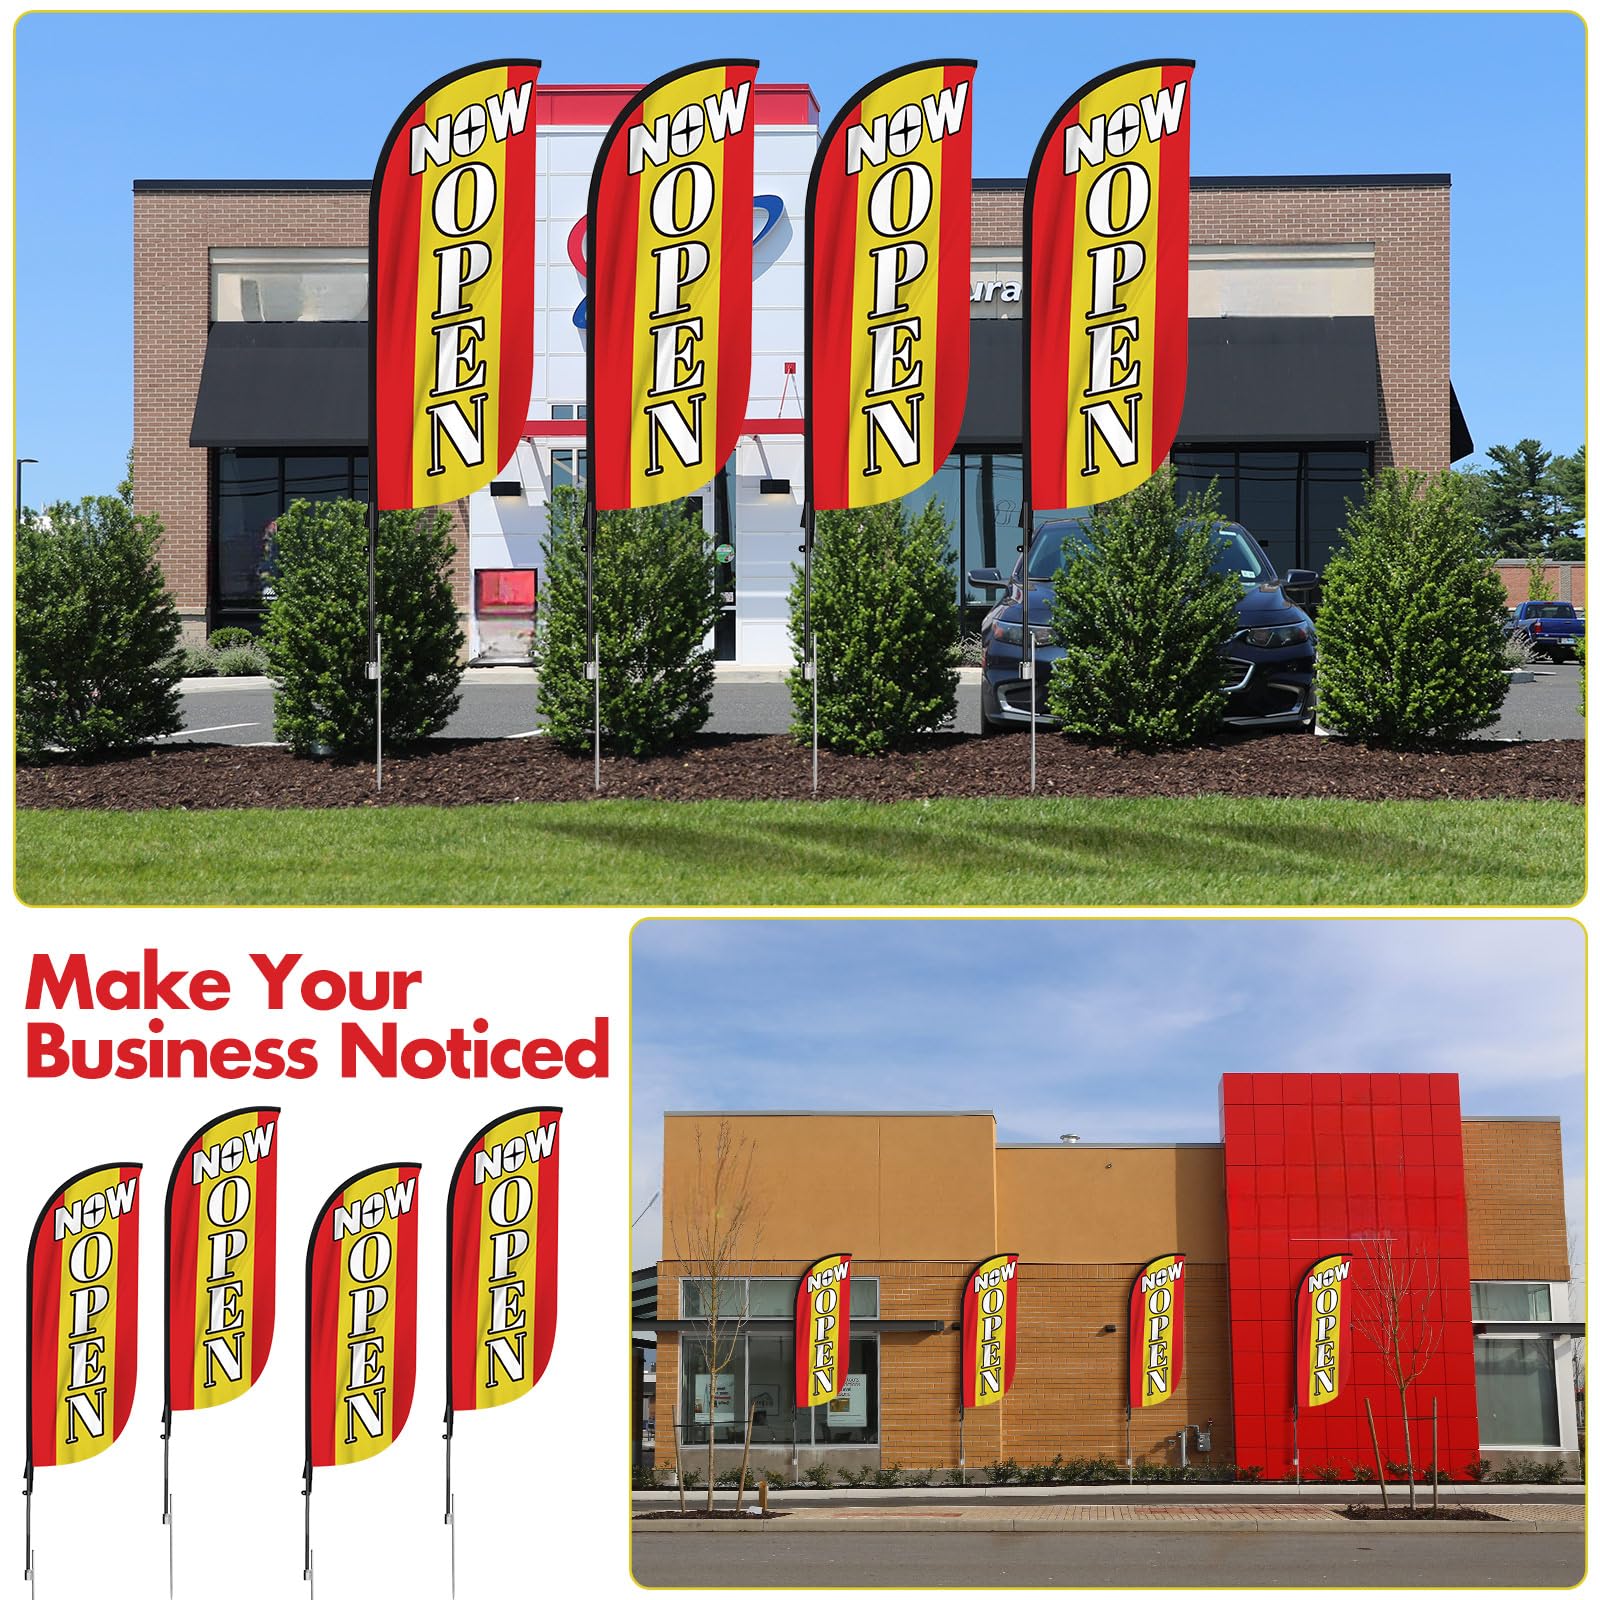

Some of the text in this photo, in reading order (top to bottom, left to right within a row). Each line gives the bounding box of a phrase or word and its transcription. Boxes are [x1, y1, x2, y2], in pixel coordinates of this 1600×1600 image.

[410, 80, 533, 175] NOW
[628, 80, 751, 175] NOW
[846, 80, 969, 175] NOW
[1064, 80, 1187, 175] NOW
[426, 162, 497, 476] OPEN
[644, 162, 715, 476] OPEN
[862, 162, 933, 476] OPEN
[1080, 162, 1151, 476] OPEN
[192, 1120, 275, 1185] NOW
[474, 1120, 557, 1185] NOW
[54, 1177, 137, 1241] NOW
[333, 1177, 416, 1241] NOW
[203, 1177, 252, 1388] OPEN
[485, 1177, 534, 1388] OPEN
[807, 1261, 850, 1293] NOW
[974, 1261, 1017, 1293] NOW
[1141, 1261, 1184, 1293] NOW
[1308, 1261, 1351, 1293] NOW
[66, 1233, 113, 1444] OPEN
[345, 1233, 392, 1444] OPEN
[813, 1288, 838, 1396] OPEN
[980, 1288, 1005, 1396] OPEN
[1147, 1288, 1172, 1396] OPEN
[1314, 1288, 1339, 1396] OPEN
